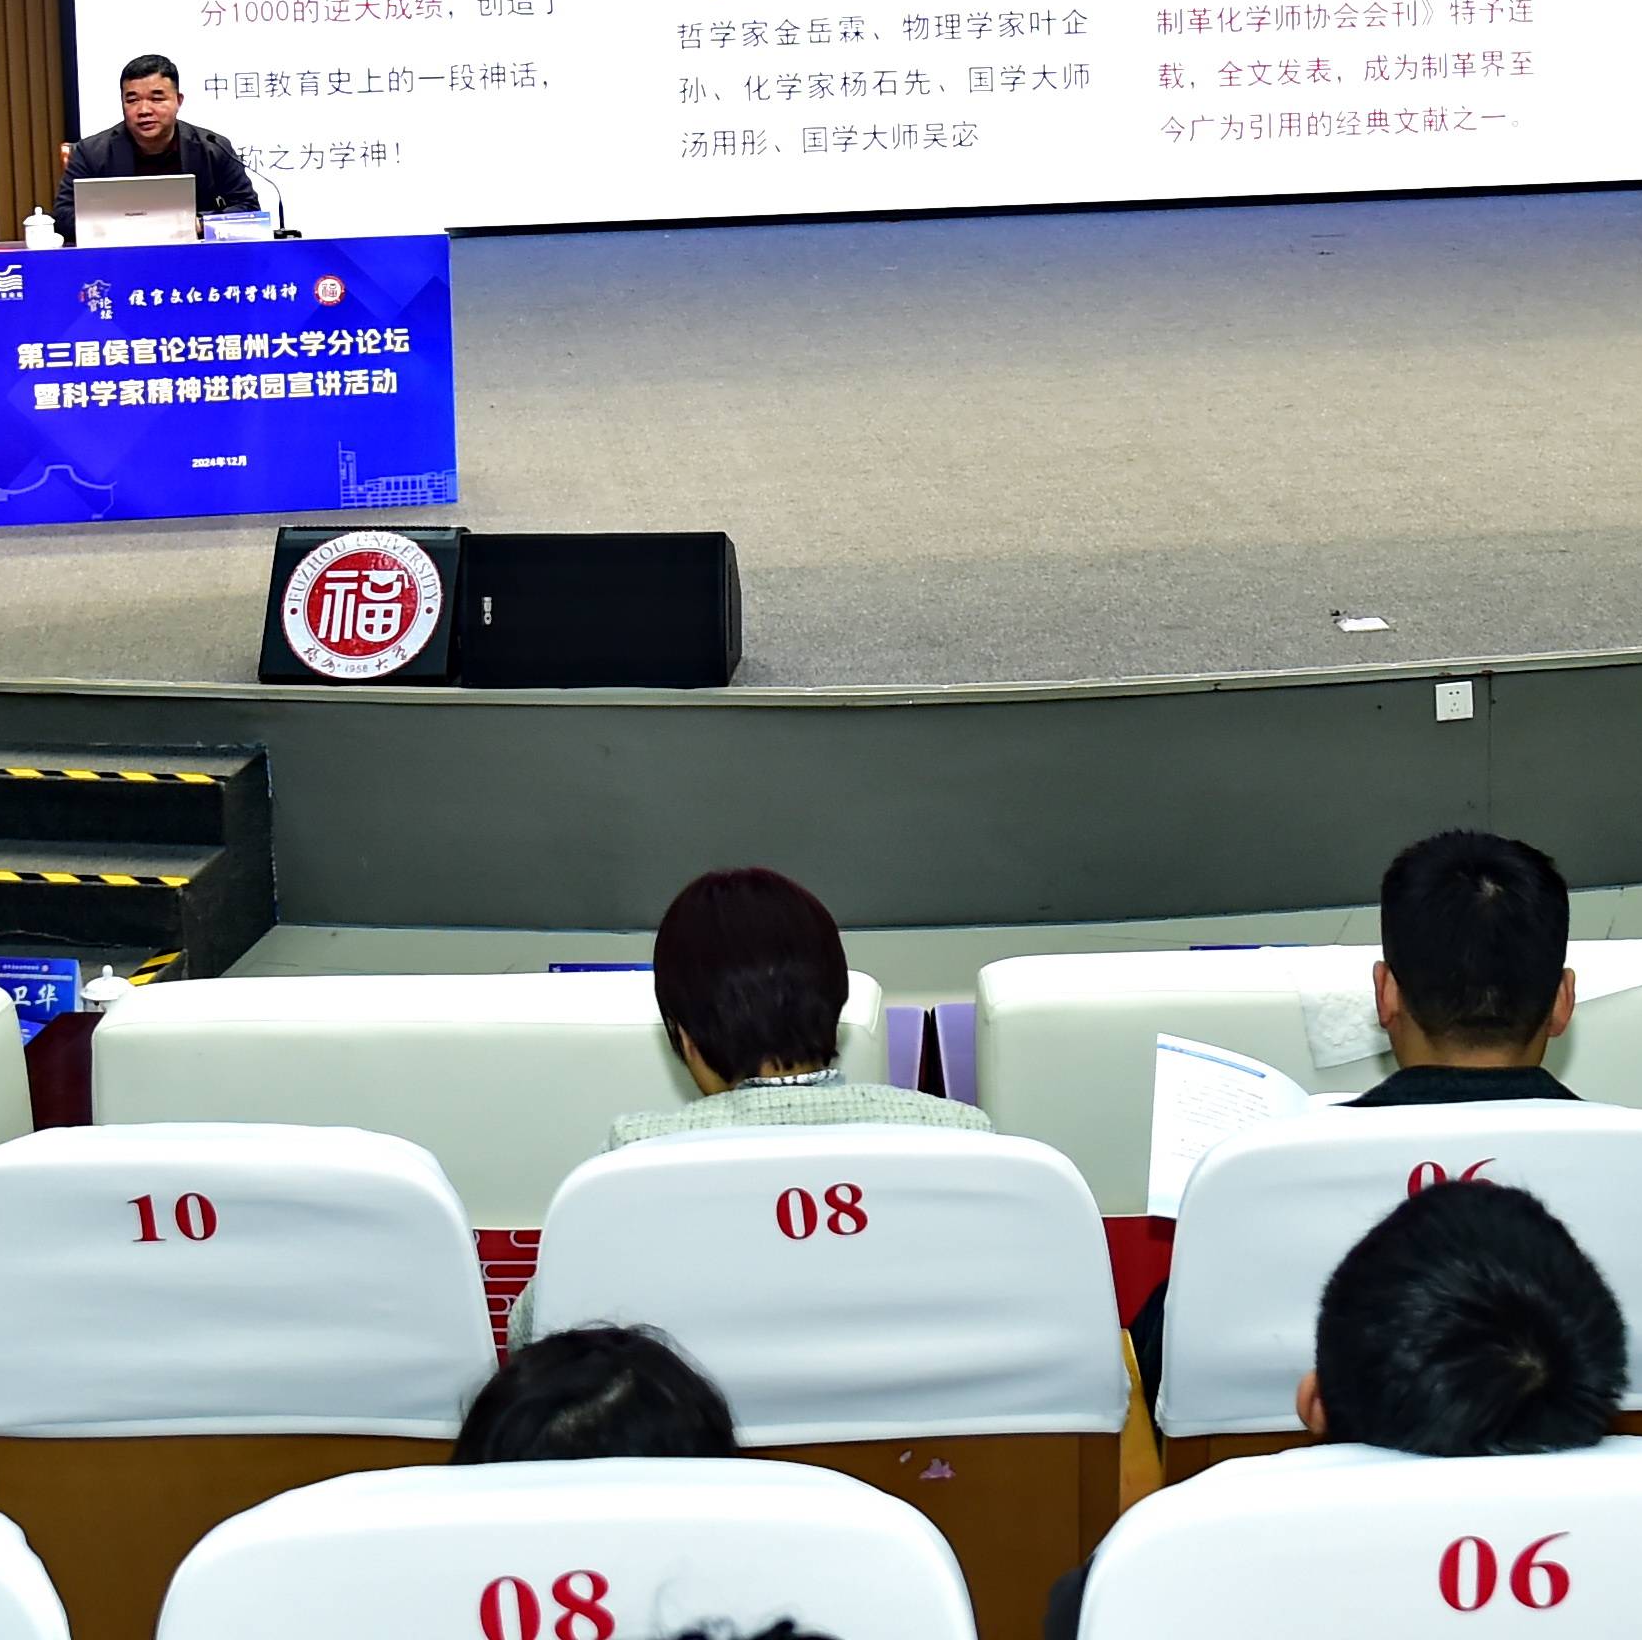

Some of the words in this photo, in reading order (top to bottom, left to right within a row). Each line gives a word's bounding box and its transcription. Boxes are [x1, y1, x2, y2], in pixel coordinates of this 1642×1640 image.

[17, 328, 410, 370] 第三届侯官论坛福州大学分论坛
[34, 368, 397, 410] 暨科学家精神进校园宣讲活动
[288, 540, 346, 602] FUZHOU
[356, 534, 438, 602] UNIVERSITY
[126, 1190, 219, 1246] 10
[775, 1181, 871, 1241] 08
[1437, 1531, 1572, 1614] 06
[478, 1569, 616, 1640] 08
